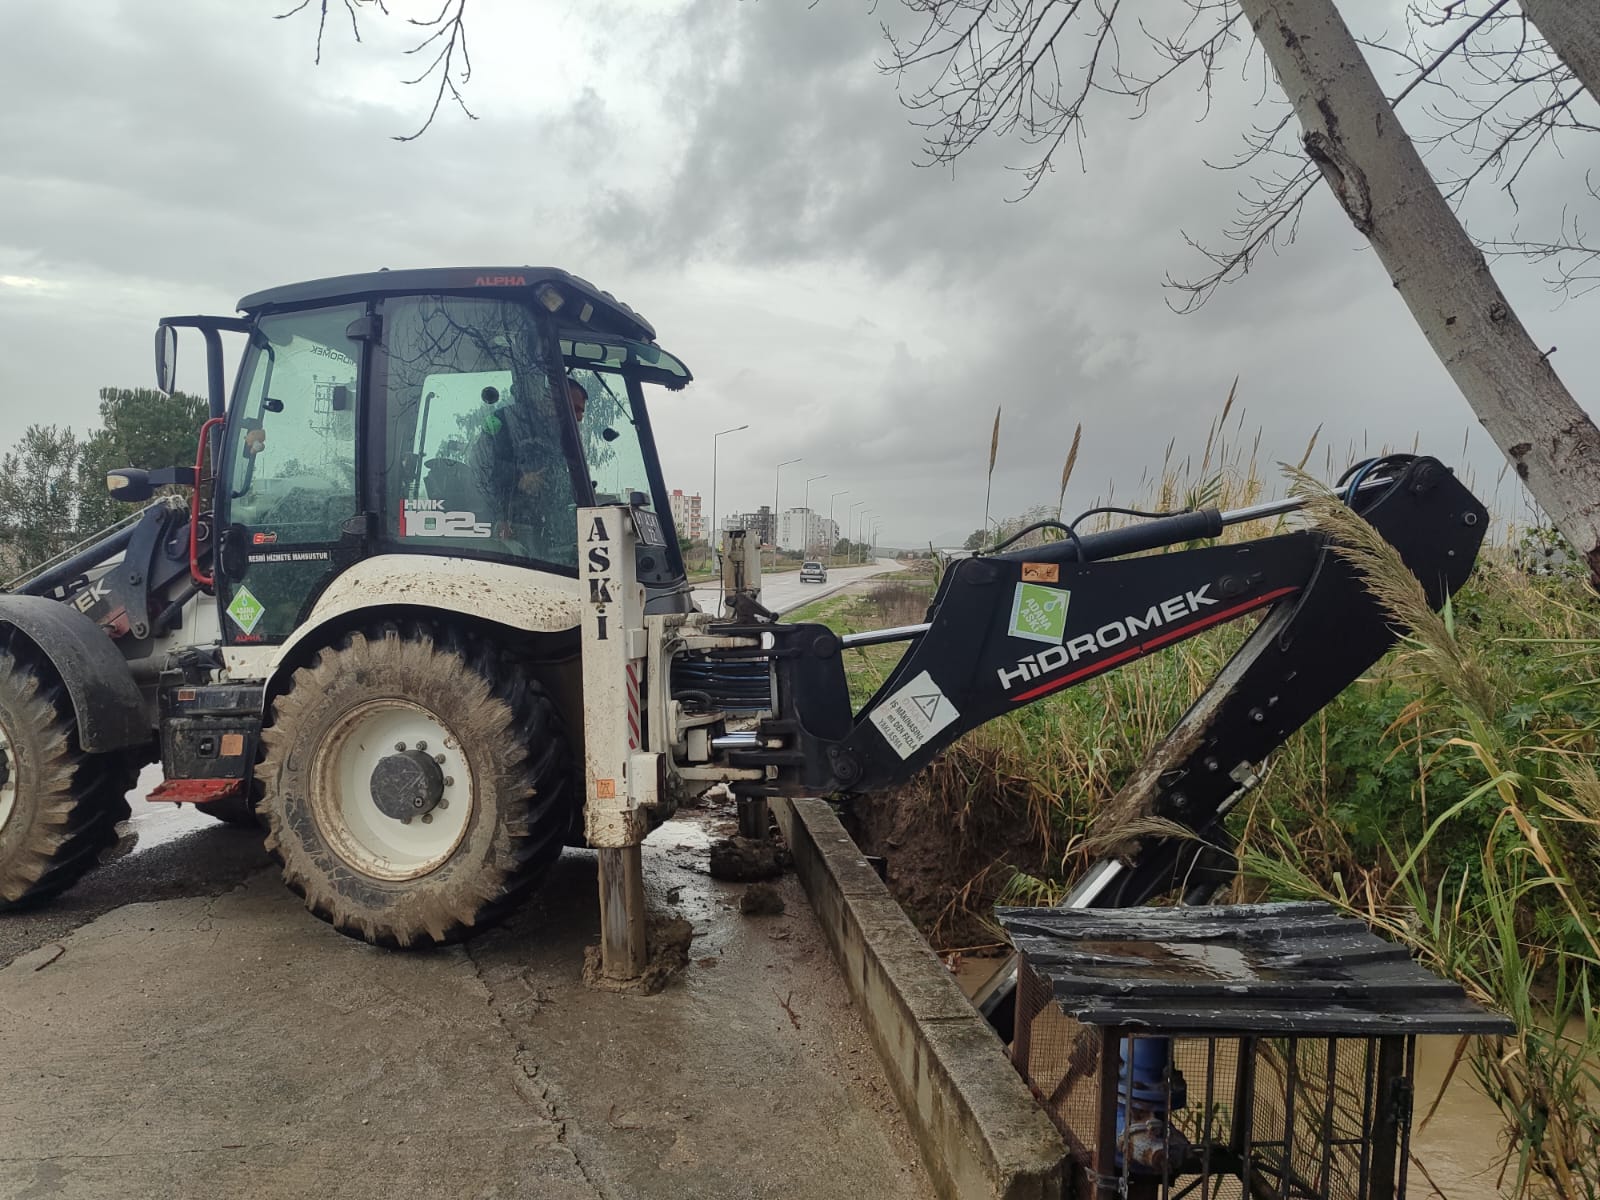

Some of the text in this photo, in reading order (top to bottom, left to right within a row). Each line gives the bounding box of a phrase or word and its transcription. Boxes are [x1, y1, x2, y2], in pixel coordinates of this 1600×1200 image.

[475, 275, 526, 287] ALPHA
[404, 499, 446, 510] HMK
[1025, 597, 1052, 631] ADANA
